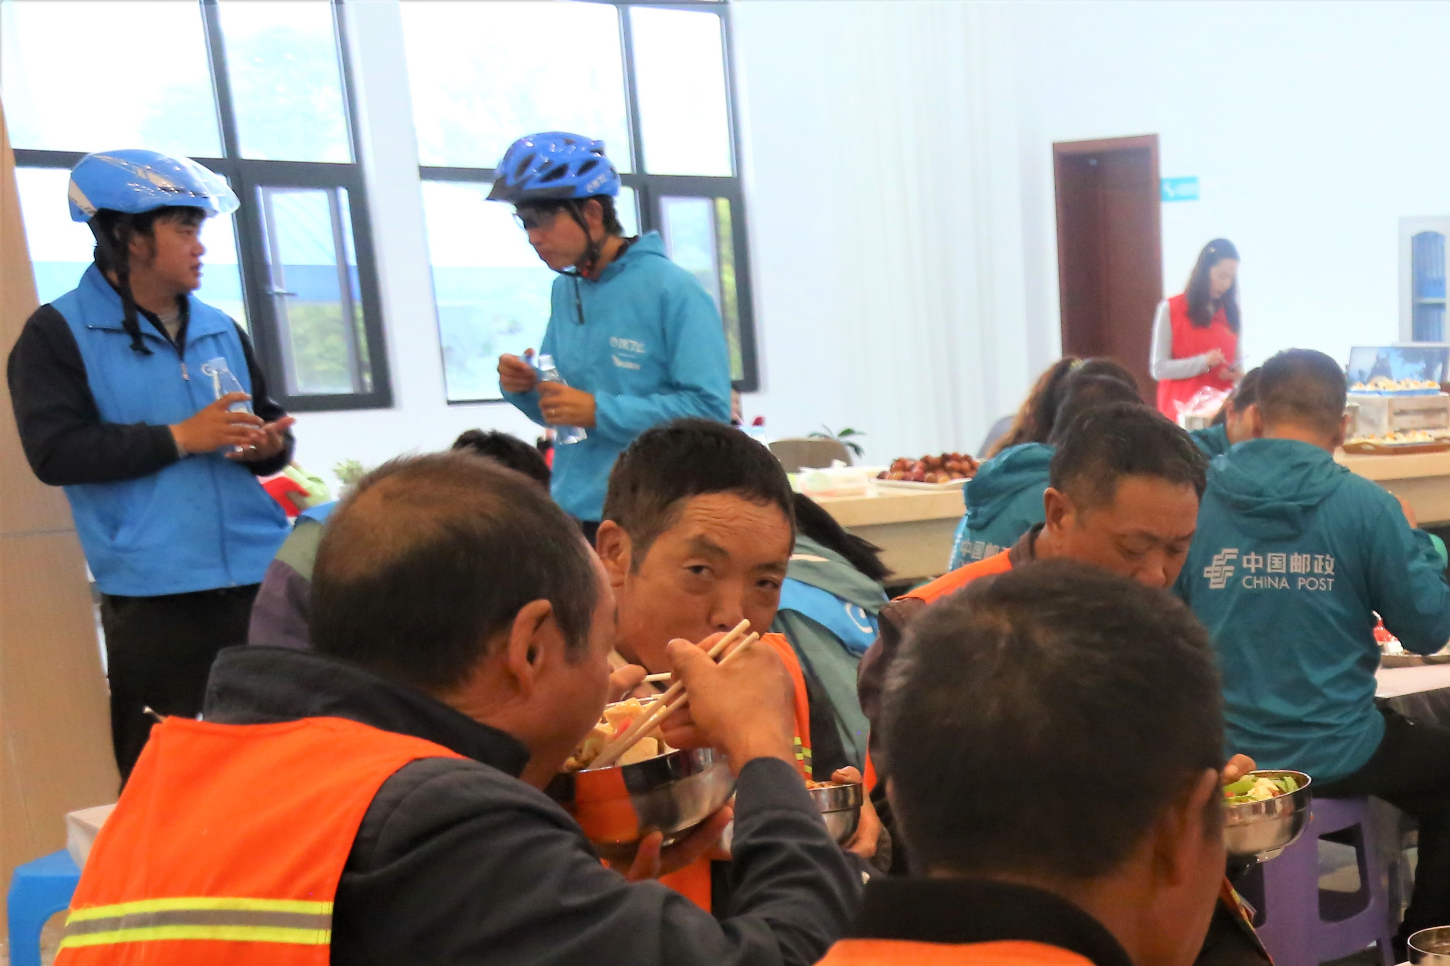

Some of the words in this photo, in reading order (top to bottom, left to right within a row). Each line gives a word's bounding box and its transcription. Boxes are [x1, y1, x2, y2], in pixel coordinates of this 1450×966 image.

[960, 539, 1006, 561] 中国邮
[1242, 551, 1335, 576] 中国邮政
[1242, 575, 1290, 590] CHINA
[1298, 577, 1335, 591] POST
